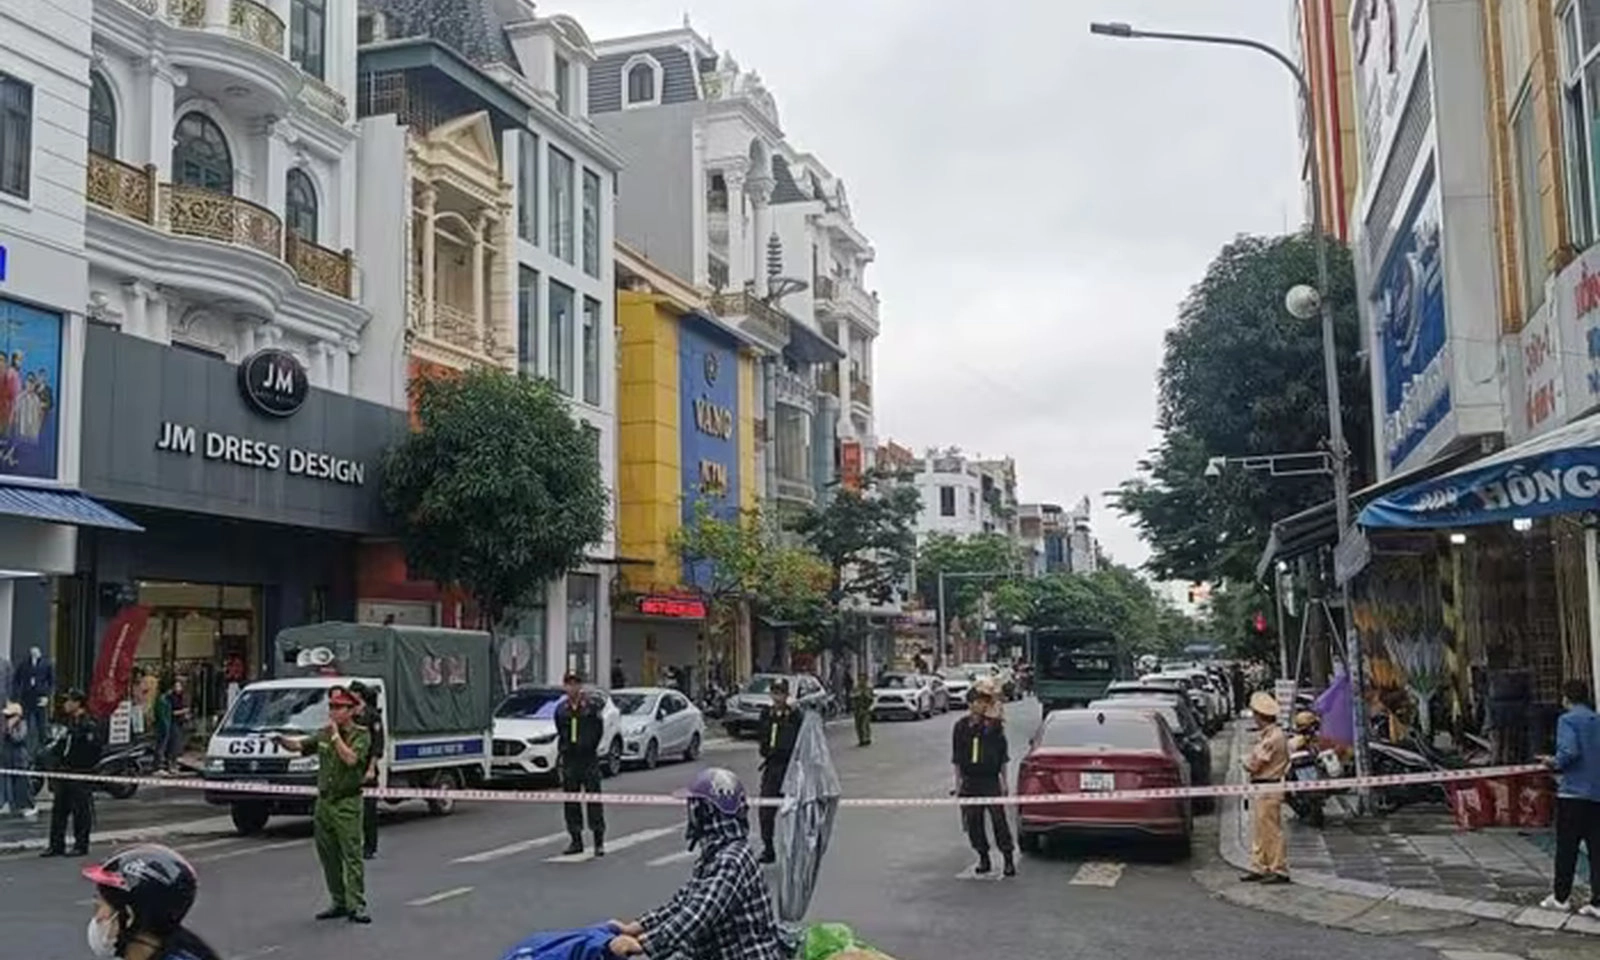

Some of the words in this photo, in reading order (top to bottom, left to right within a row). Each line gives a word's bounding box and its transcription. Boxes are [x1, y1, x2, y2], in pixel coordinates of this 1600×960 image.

[262, 362, 293, 394] JM
[158, 421, 196, 453] JM
[206, 432, 281, 469] DRESS
[289, 449, 365, 485] DESIGN
